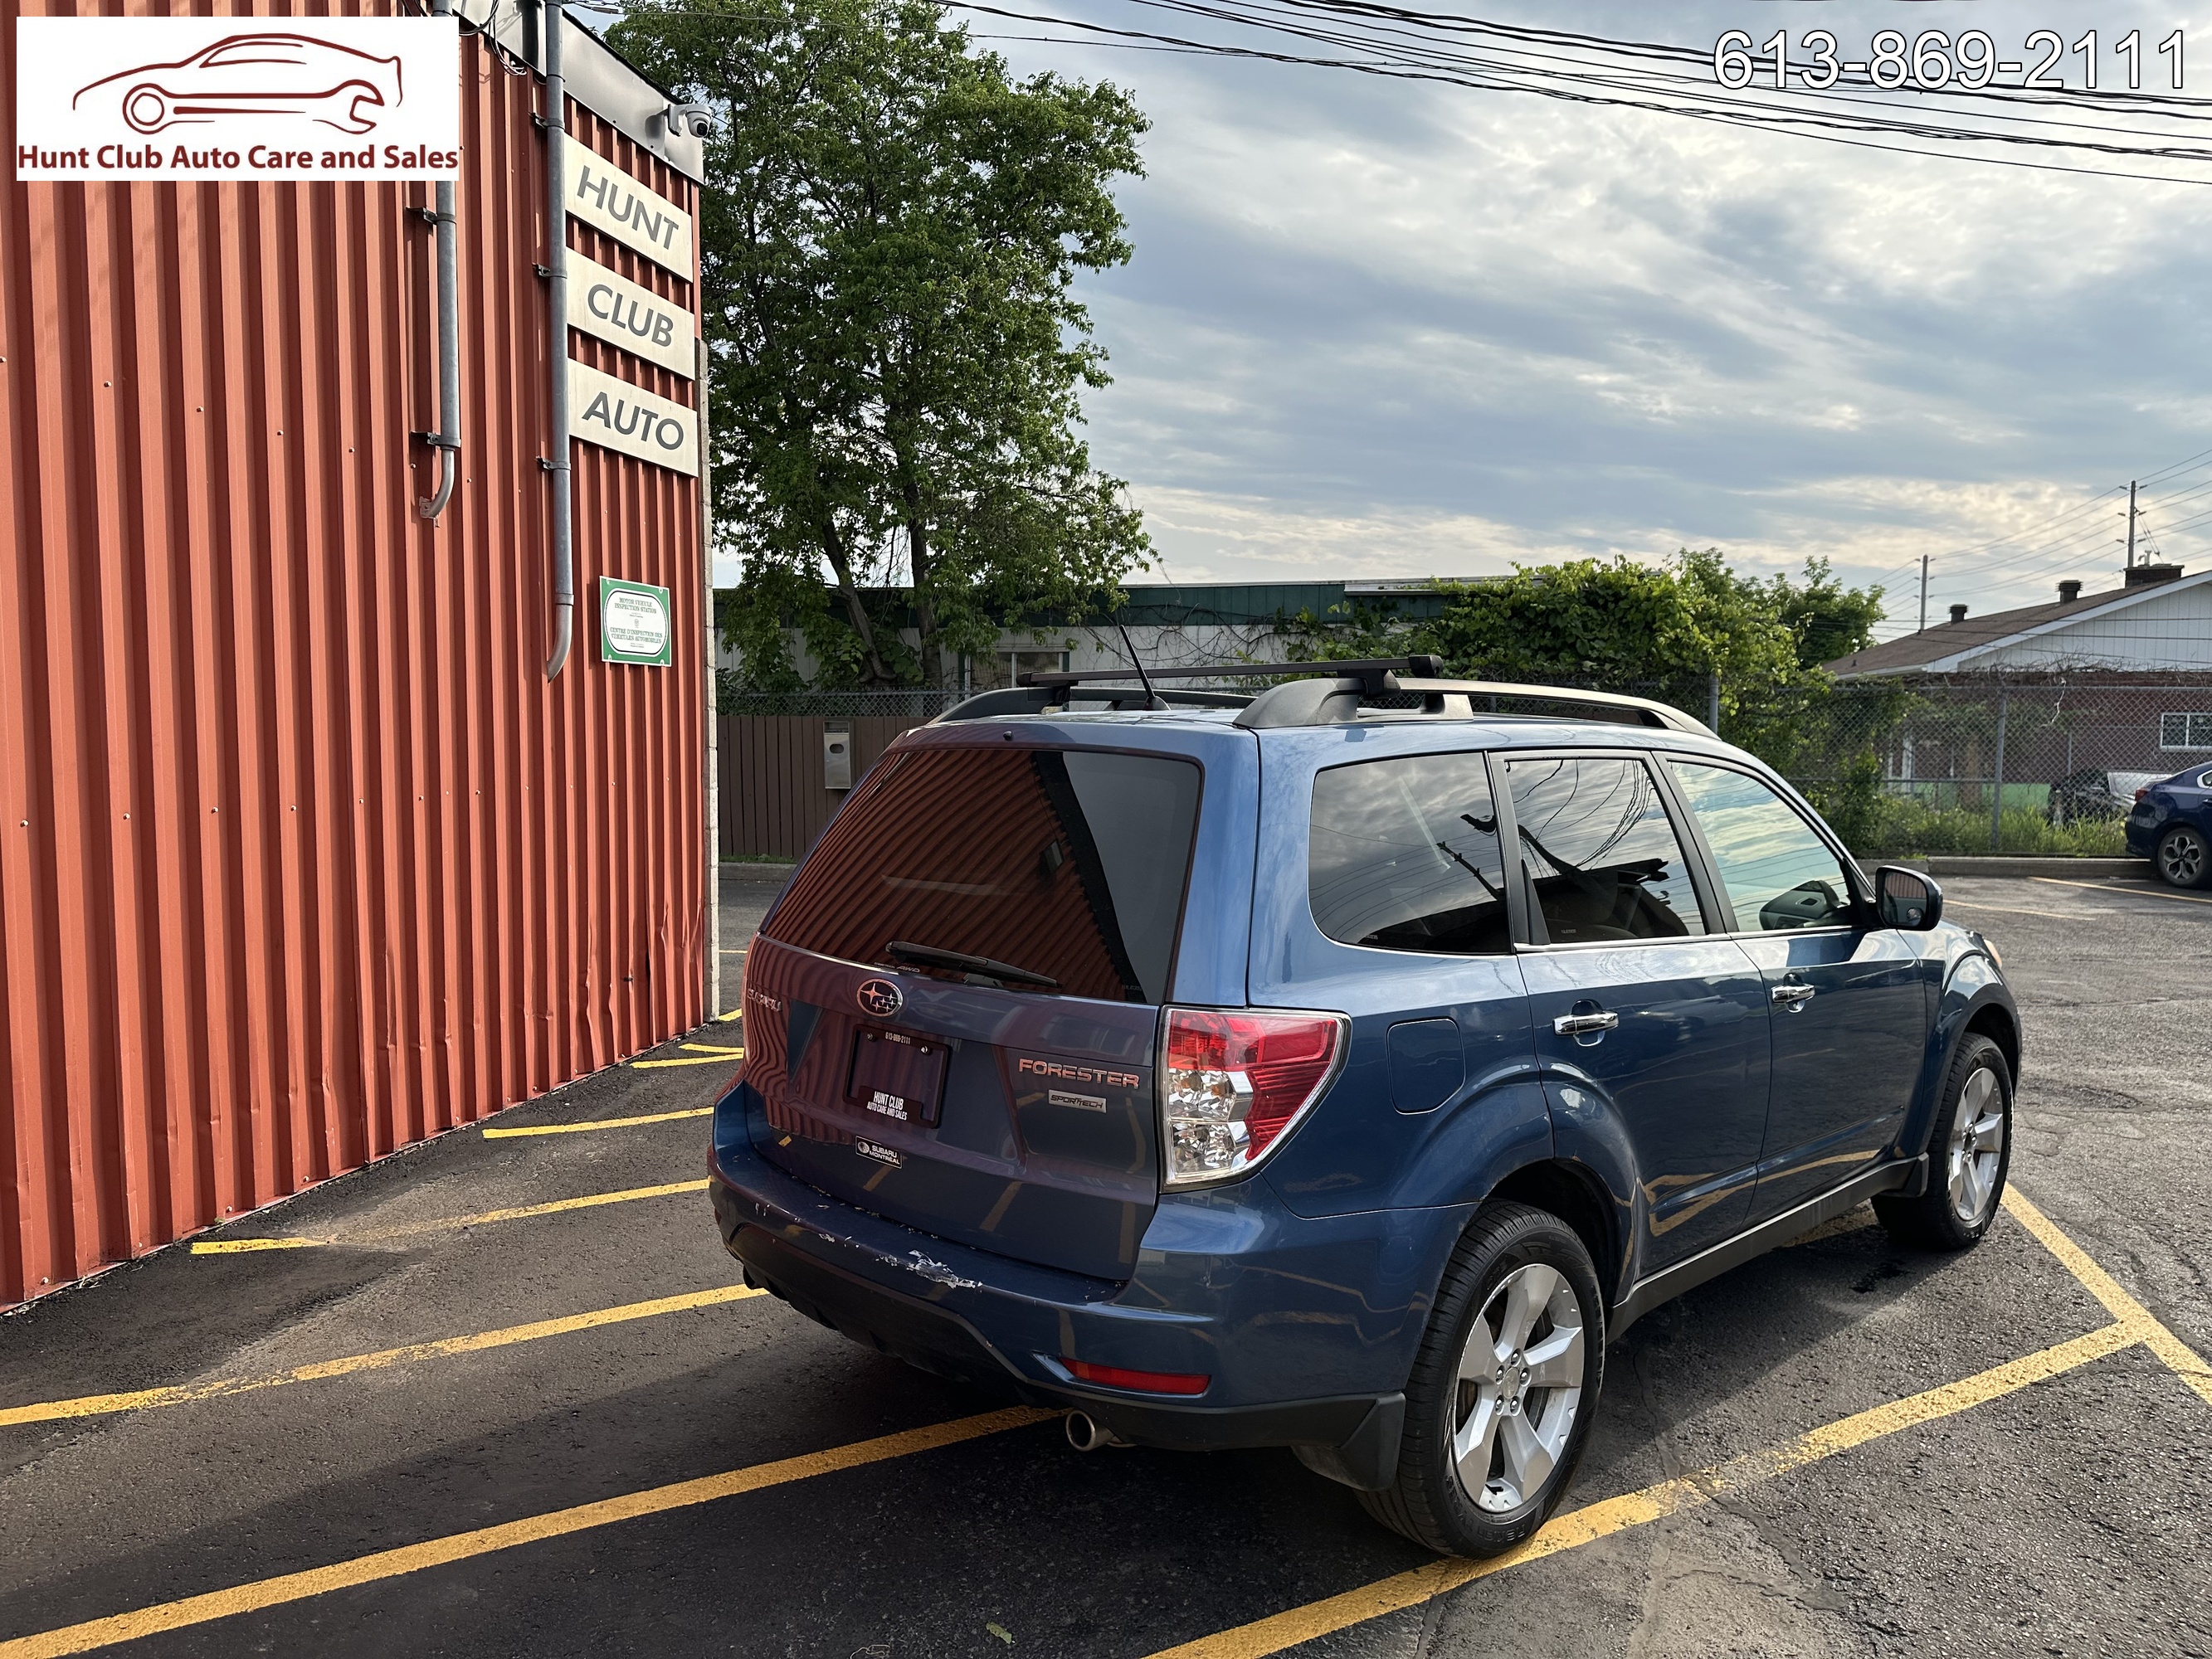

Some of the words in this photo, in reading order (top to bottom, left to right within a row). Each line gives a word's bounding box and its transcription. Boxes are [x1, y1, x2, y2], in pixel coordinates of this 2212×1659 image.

[577, 164, 680, 251] HUNT
[587, 284, 674, 348] CLUB
[581, 391, 685, 450] AUTO
[1019, 1058, 1139, 1089] FORESTER
[866, 1101, 877, 1112] AUTO
[876, 1104, 888, 1115] CARE
[886, 1107, 895, 1117] AND
[894, 1109, 908, 1121] SALES
[873, 1091, 889, 1107] HUNT
[888, 1095, 904, 1110] CLUB
[871, 1145, 898, 1158] SUBARU
